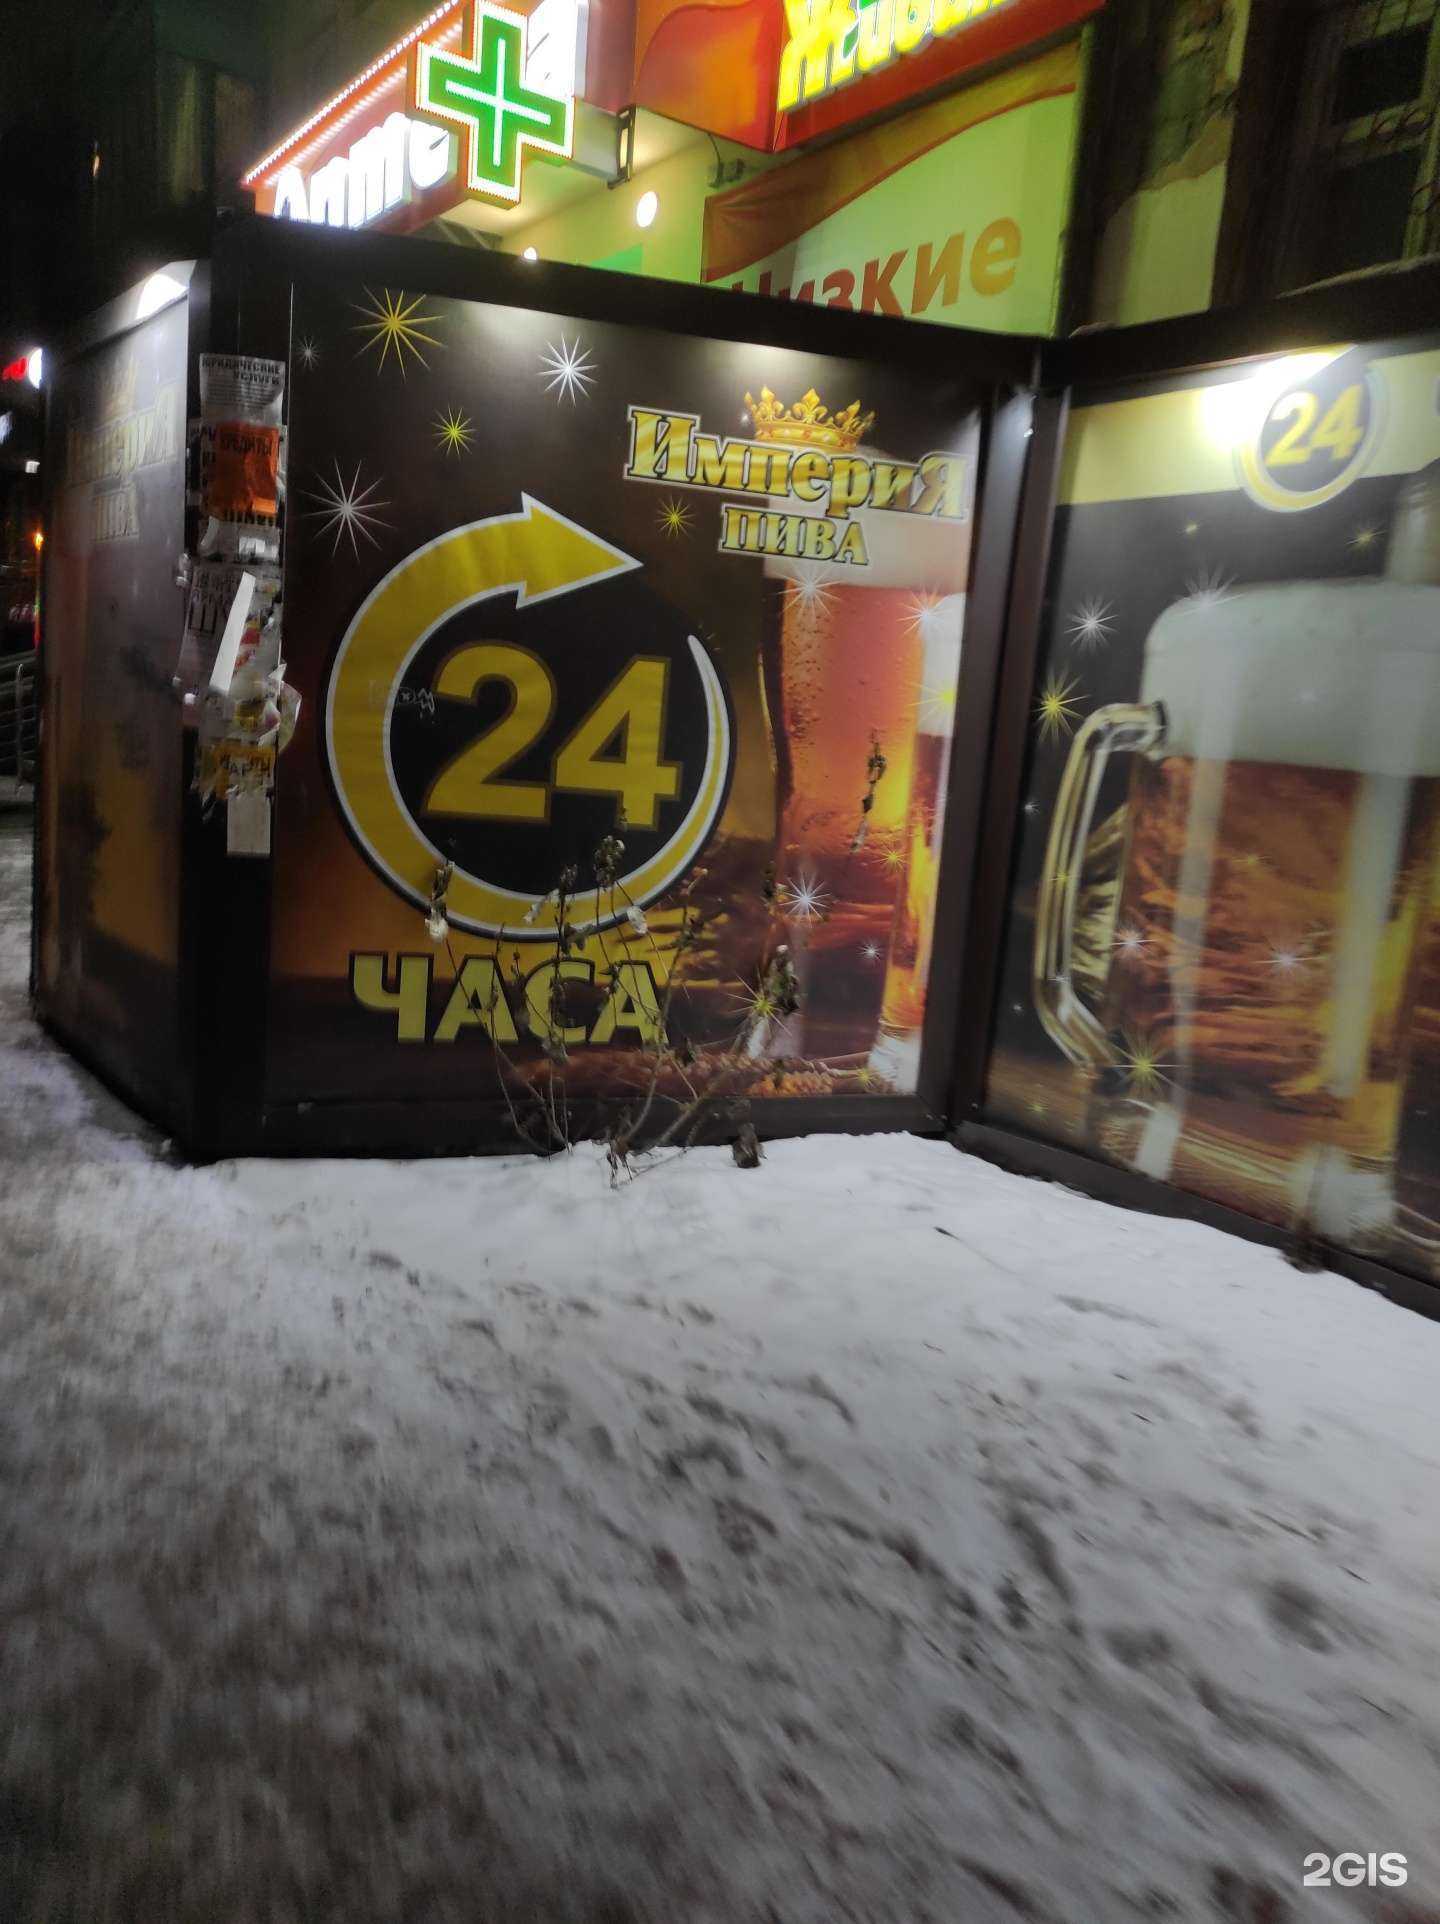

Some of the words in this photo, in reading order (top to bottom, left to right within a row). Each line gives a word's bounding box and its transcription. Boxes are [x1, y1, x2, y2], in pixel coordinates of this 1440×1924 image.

[730, 216, 1022, 318] зкие
[1263, 383, 1365, 468] 24
[718, 504, 869, 566] ПИВА
[423, 640, 682, 831] 24
[350, 952, 670, 1044] ЧАСА
